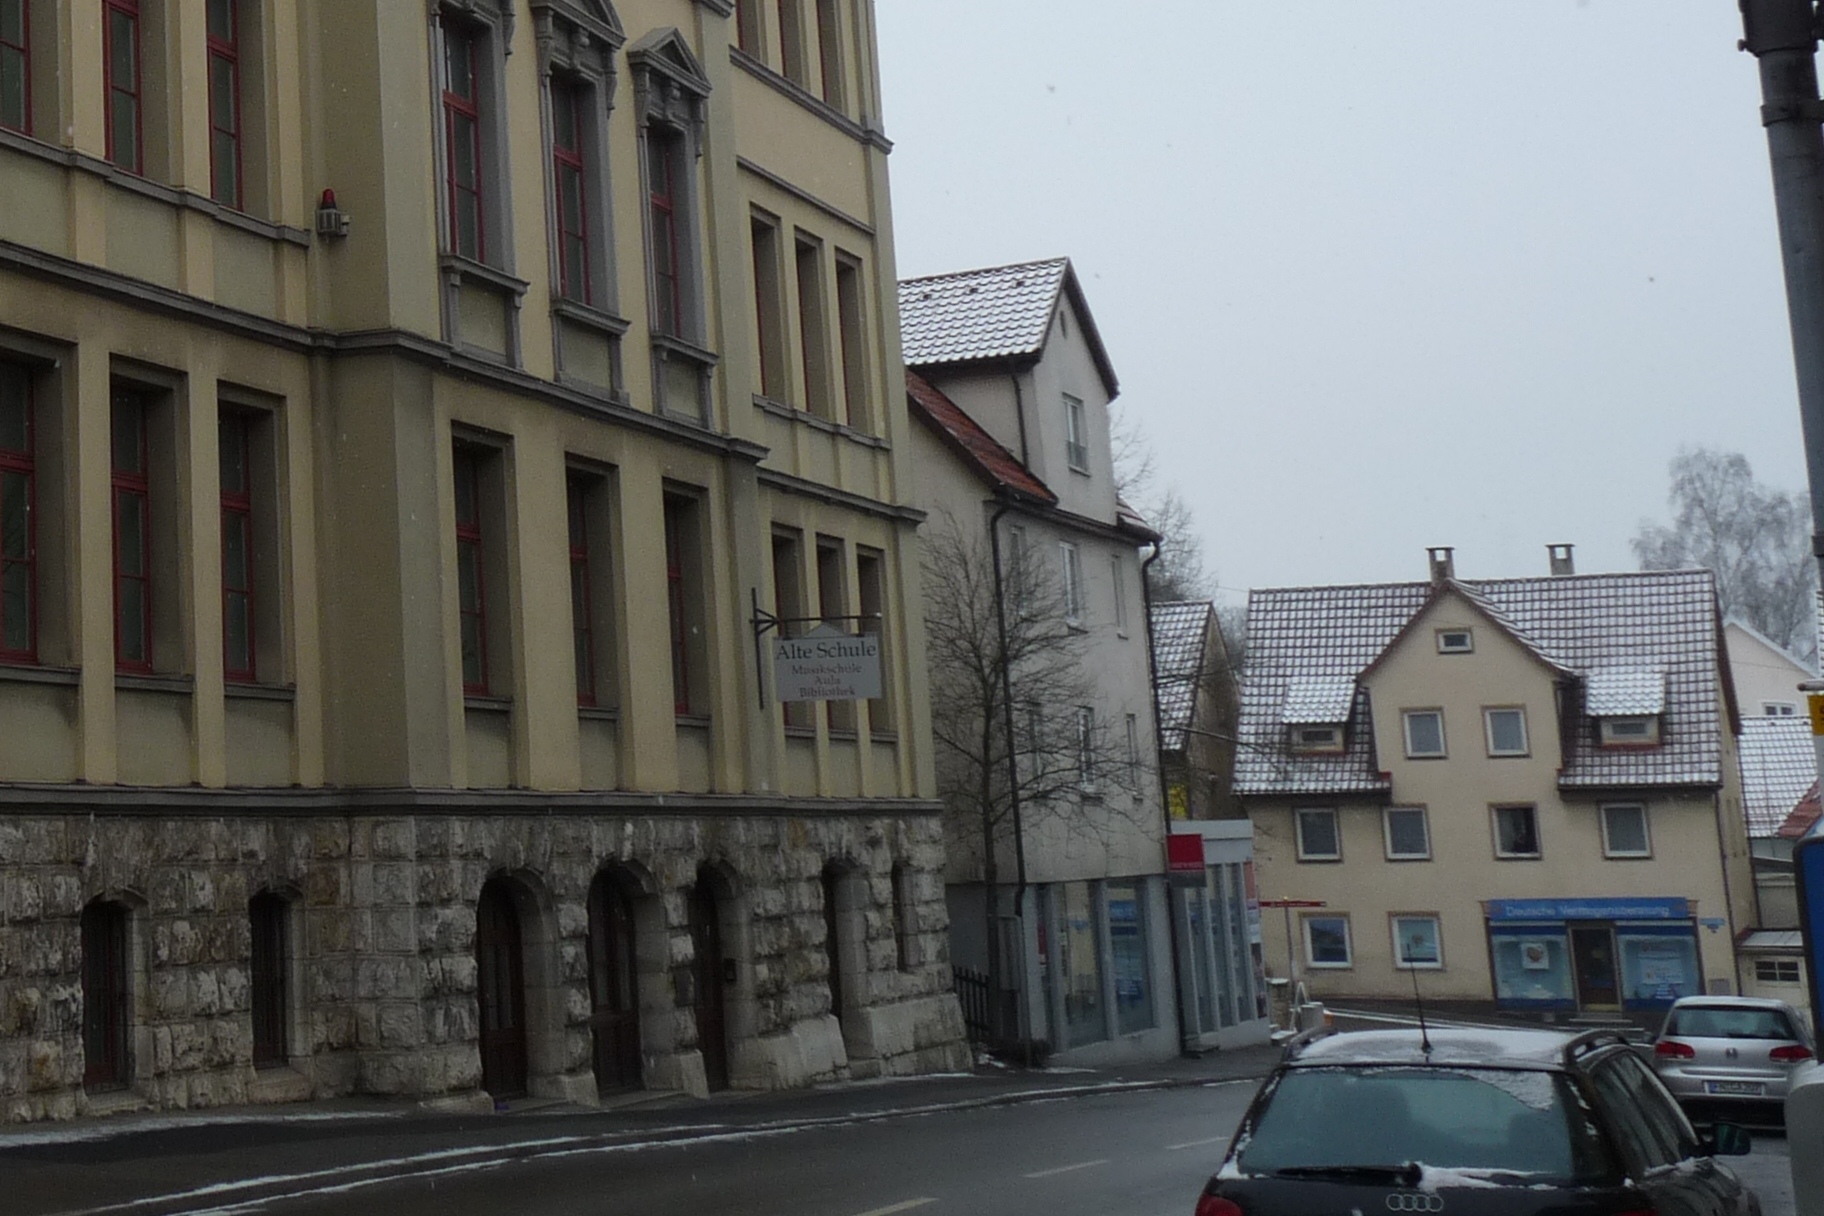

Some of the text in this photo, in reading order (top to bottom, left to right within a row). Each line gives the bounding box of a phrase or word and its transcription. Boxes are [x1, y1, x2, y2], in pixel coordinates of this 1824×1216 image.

[776, 641, 876, 660] Alte Schule
[799, 686, 855, 698] Bibliothek
